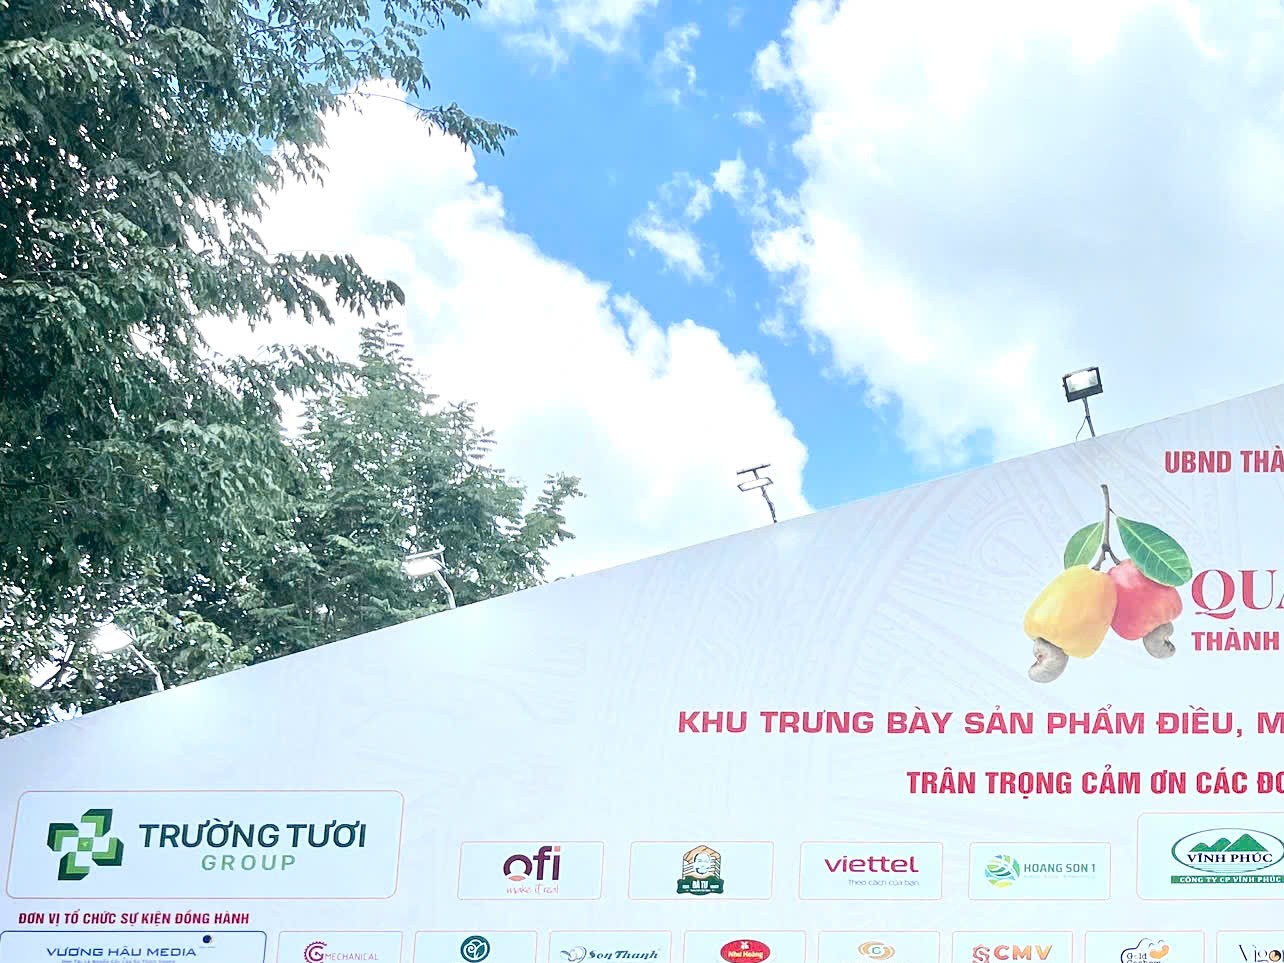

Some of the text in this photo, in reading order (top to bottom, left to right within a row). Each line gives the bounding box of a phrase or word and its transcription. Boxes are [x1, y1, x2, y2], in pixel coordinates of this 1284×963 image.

[1164, 449, 1231, 474] UBND
[1191, 627, 1281, 652] THÀNH
[678, 711, 747, 734] KHU
[760, 710, 874, 734] TRƯNG
[887, 705, 955, 734] BÀY
[964, 705, 1034, 734] SẢN
[1047, 703, 1145, 734] PHẨM
[1155, 704, 1243, 738] ĐIỀU,
[907, 767, 975, 794] TRÂN
[985, 771, 1072, 799] TRỌNG
[1082, 764, 1141, 794] CẢM
[1150, 769, 1188, 794] ƠN
[1196, 765, 1248, 794] CÁC
[138, 818, 367, 848] TRƯỜNG TƯƠI
[201, 854, 297, 871] GROUP
[503, 846, 560, 881] ofi
[824, 856, 919, 872] viettel
[1187, 851, 1273, 862] VĨNH PHÚC
[1024, 863, 1096, 873] HOANG SON 1
[1180, 875, 1203, 883] CÔNG
[18, 911, 44, 924] ĐƠN
[48, 912, 60, 926] VỊ
[64, 909, 80, 924] TỔ
[83, 910, 116, 924] CHỨC
[120, 912, 138, 927] SỰ
[141, 911, 171, 927] KIỆN
[214, 910, 249, 924] HÀNH
[47, 946, 103, 957] VƯƠNG
[147, 947, 196, 957] MEDIA
[994, 944, 1053, 961] CMV
